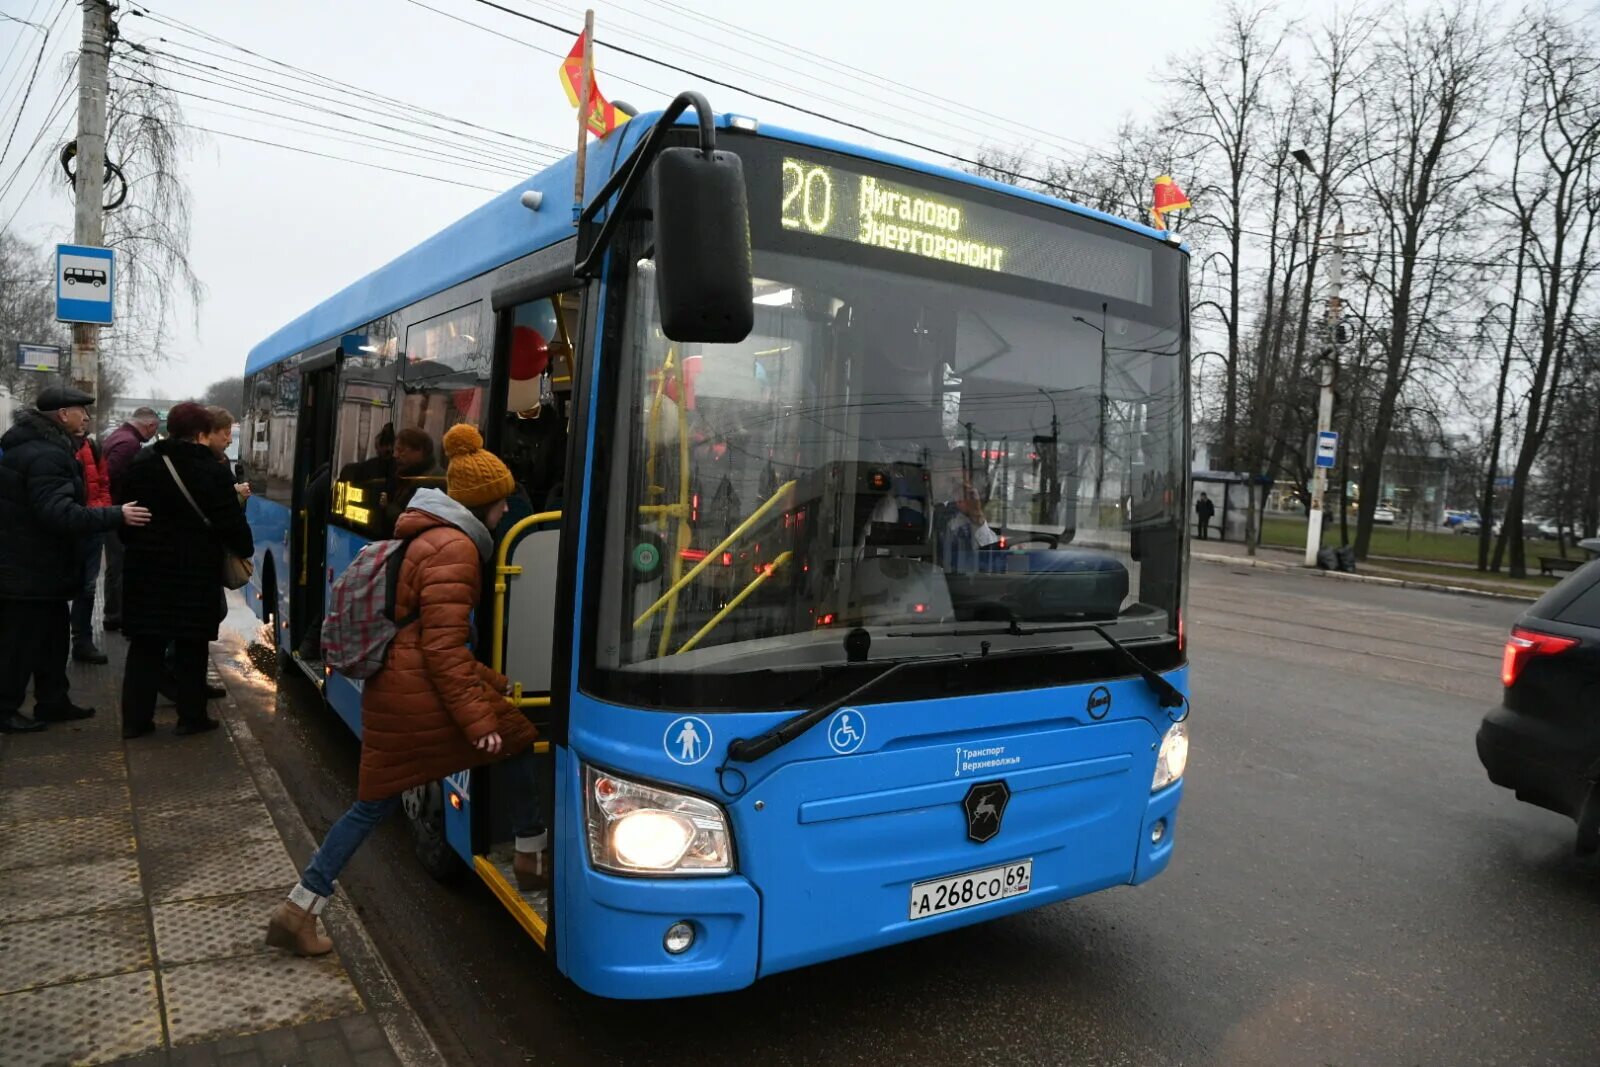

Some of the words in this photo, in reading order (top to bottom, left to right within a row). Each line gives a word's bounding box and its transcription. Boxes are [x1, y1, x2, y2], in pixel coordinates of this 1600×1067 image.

[781, 156, 832, 234] 20
[857, 215, 1003, 272] Энергоремонт
[962, 756, 1021, 772] Верхневолжья
[963, 746, 1006, 760] Транспорт
